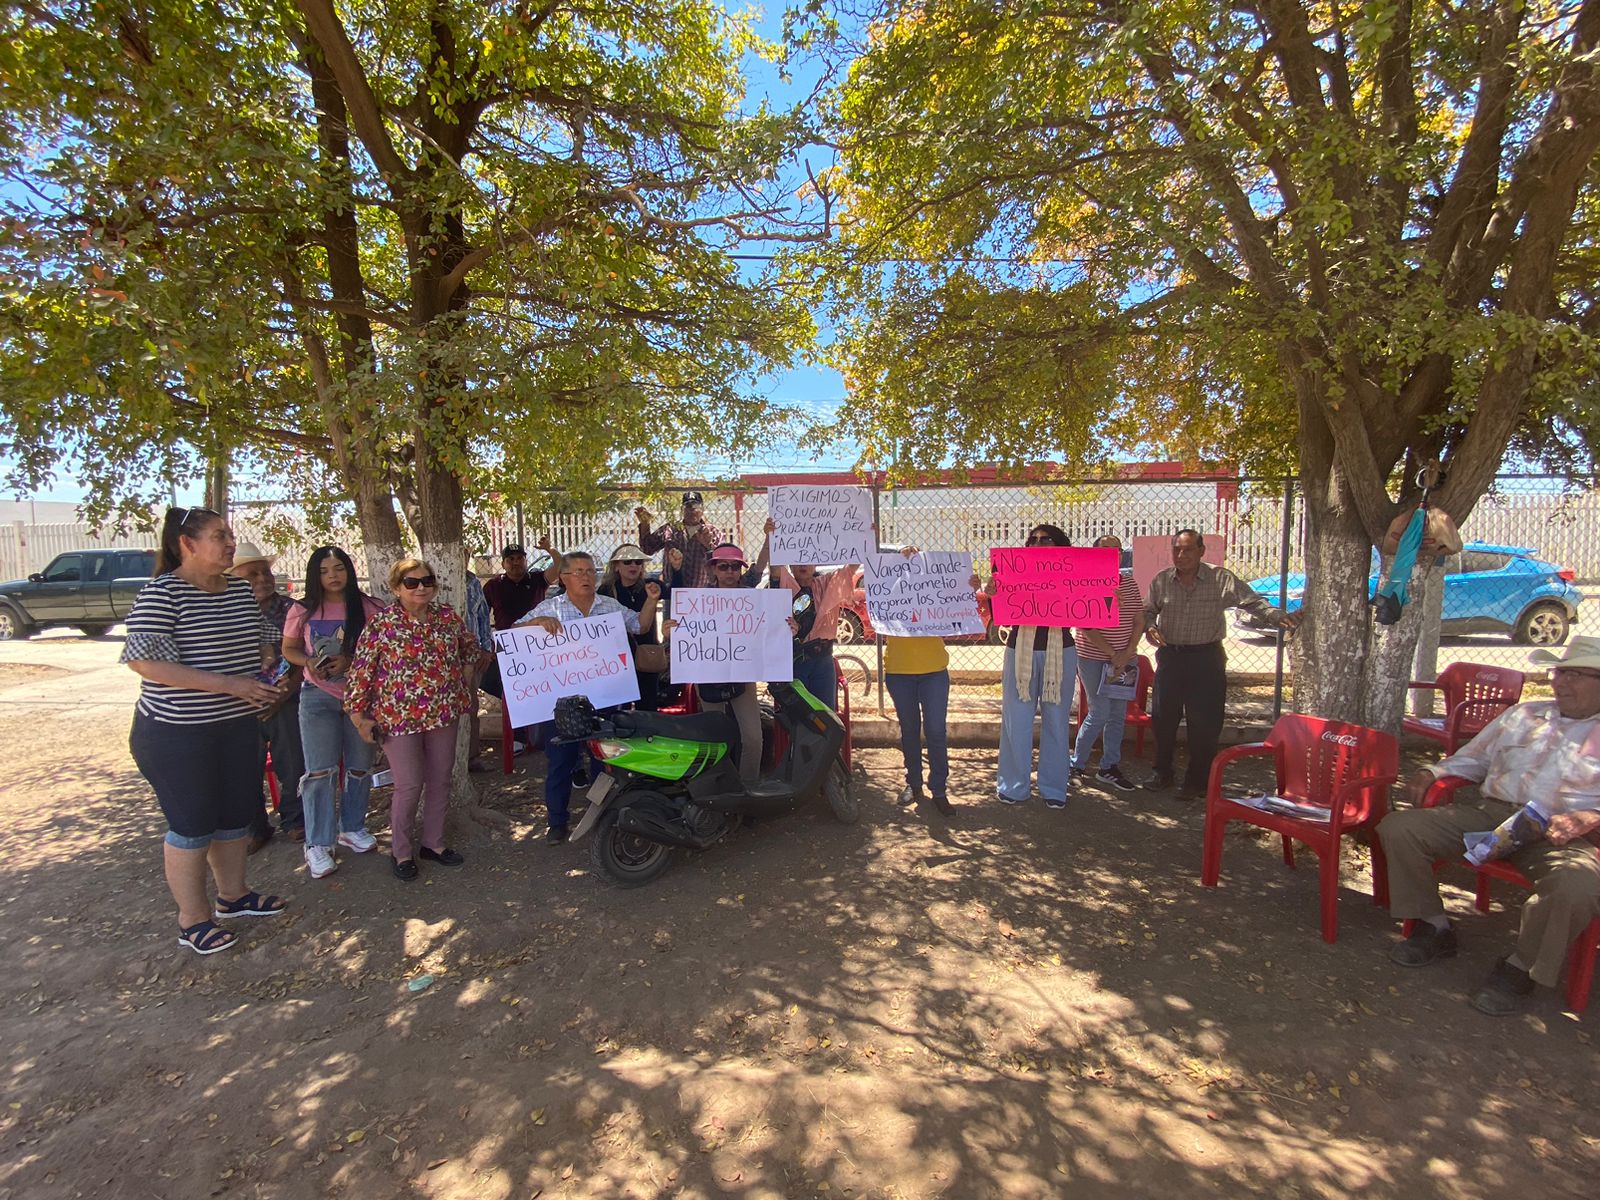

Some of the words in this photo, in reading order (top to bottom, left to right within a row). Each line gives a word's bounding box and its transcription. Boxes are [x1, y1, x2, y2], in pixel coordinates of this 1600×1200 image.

[774, 505, 838, 519] SOLUCION
[774, 520, 832, 535] PROBLEMA
[842, 521, 865, 532] DEL
[923, 553, 967, 575] Lande-
[1062, 576, 1118, 593] queremos
[675, 590, 754, 615] Exigimos
[869, 597, 913, 611] mejorar
[917, 593, 934, 605] los
[1007, 592, 1114, 619] Solución!
[674, 615, 718, 639] Agua
[724, 611, 766, 635] 100%
